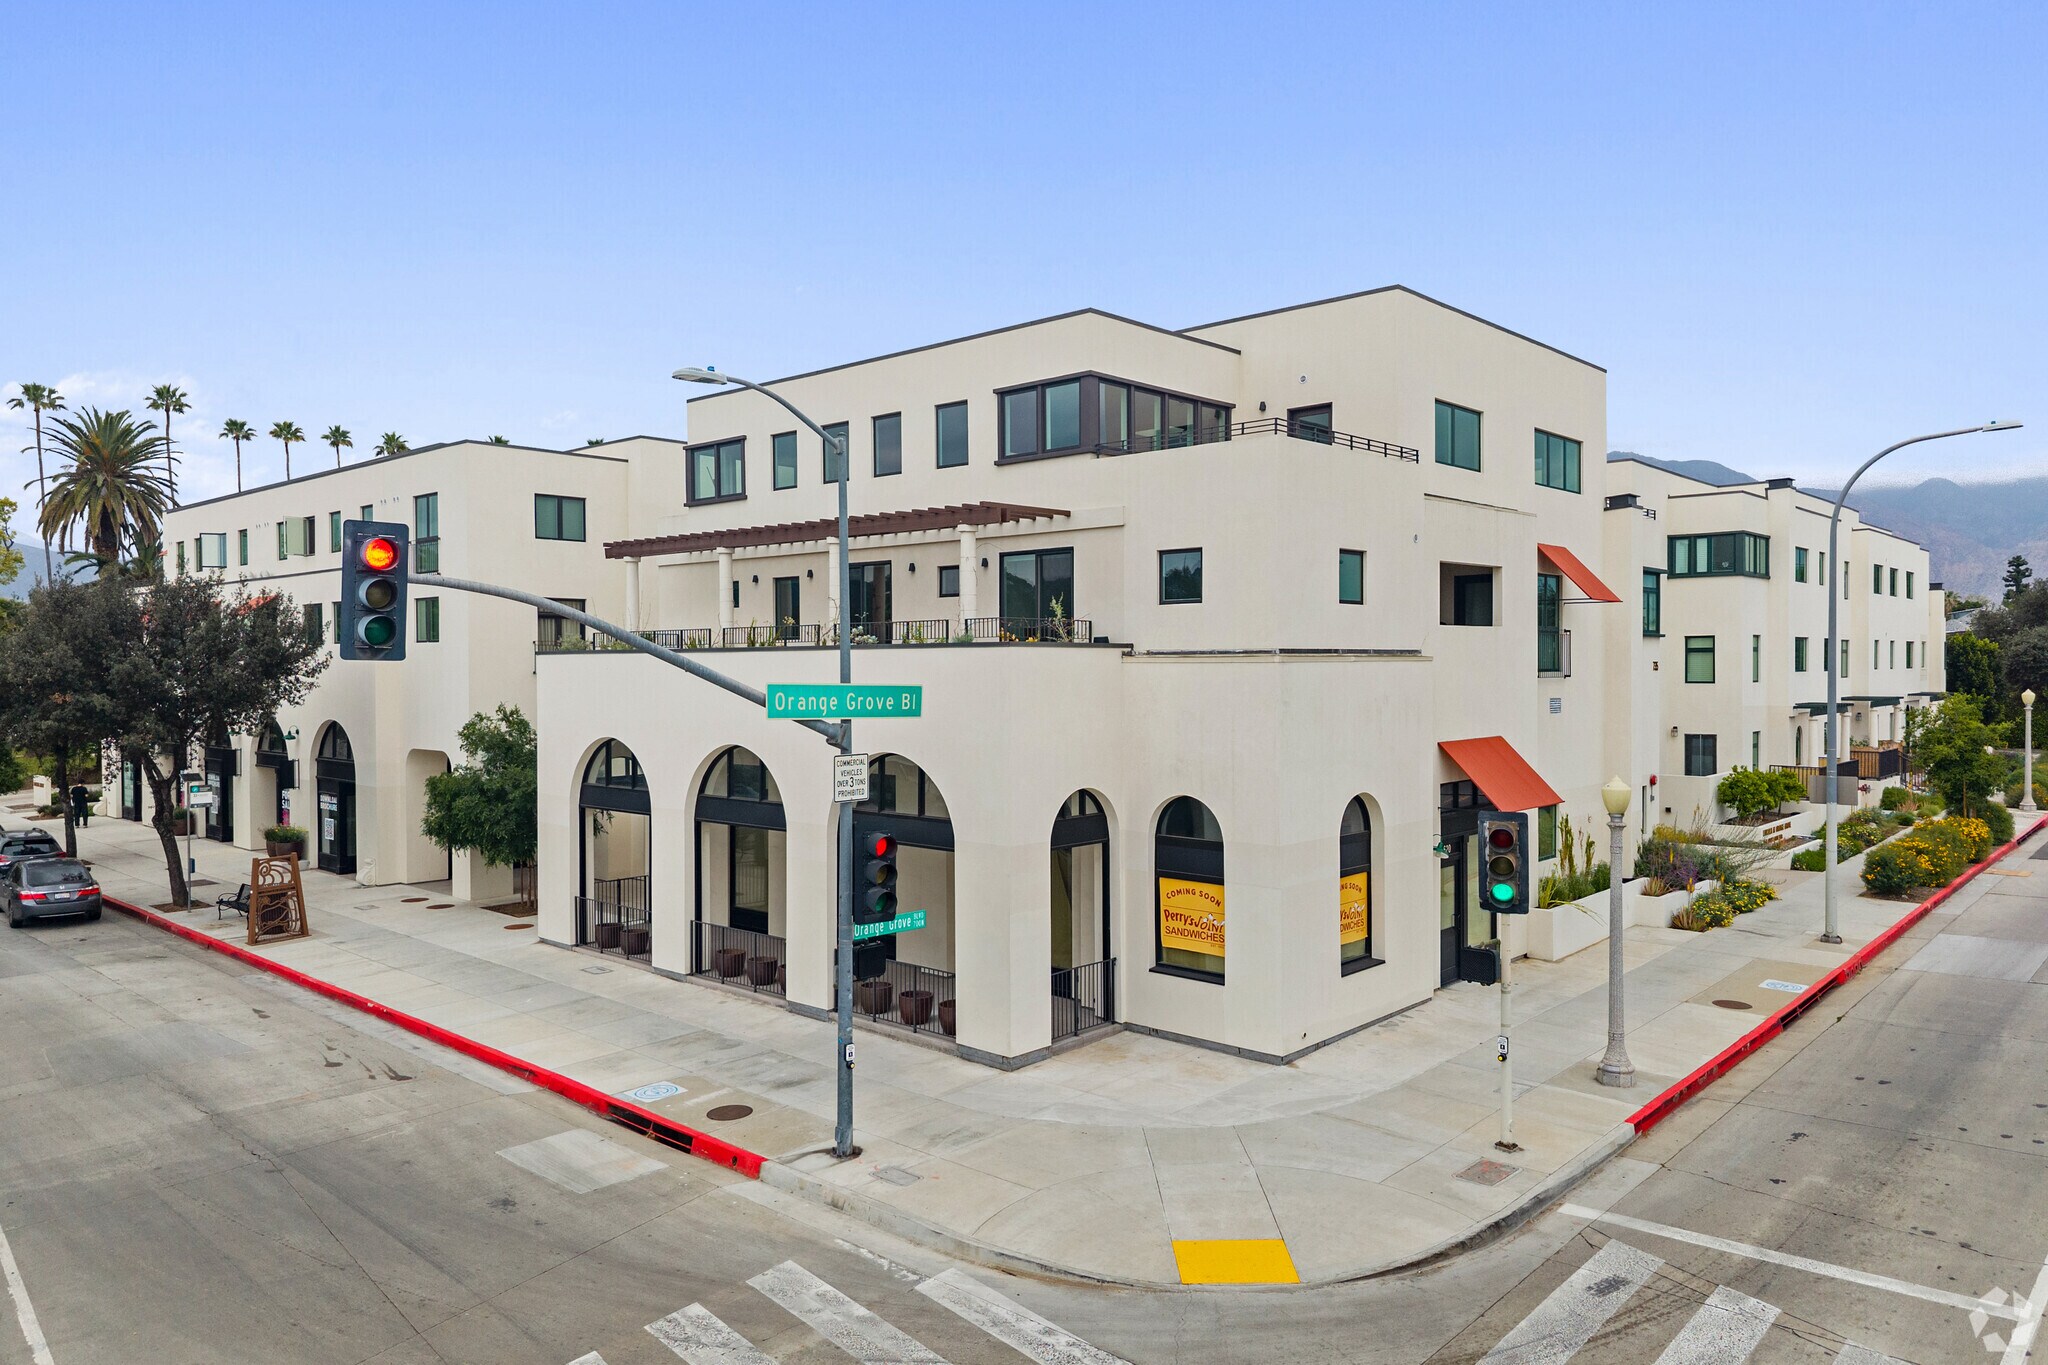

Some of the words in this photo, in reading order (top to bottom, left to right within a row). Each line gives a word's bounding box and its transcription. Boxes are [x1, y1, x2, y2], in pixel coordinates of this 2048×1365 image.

[775, 692, 838, 716] Orange
[846, 692, 894, 710] Grove
[901, 693, 916, 710] Bl
[837, 759, 866, 767] COMMERCIAL
[841, 769, 863, 777] VEHICLES
[837, 780, 848, 788] OVER
[849, 776, 855, 788] 3
[855, 778, 866, 786] TONS
[838, 789, 865, 797] PROHIBITED
[1166, 888, 1196, 899] COMING
[1199, 890, 1221, 907] SOON
[1164, 909, 1195, 926] Perry's
[854, 923, 884, 936] Orange
[889, 917, 911, 930] Grove
[1165, 926, 1225, 943] SANDWICHES
